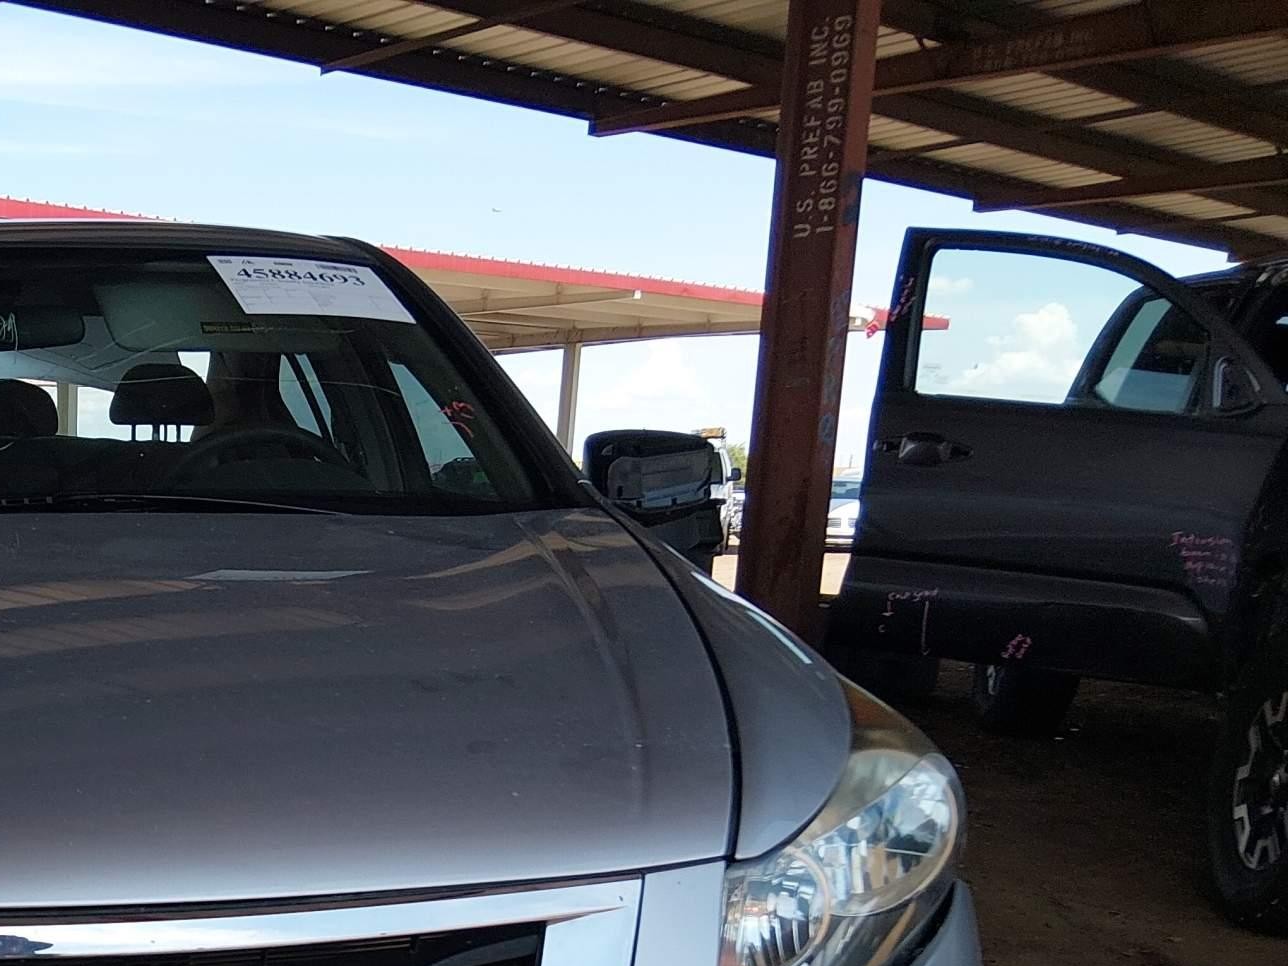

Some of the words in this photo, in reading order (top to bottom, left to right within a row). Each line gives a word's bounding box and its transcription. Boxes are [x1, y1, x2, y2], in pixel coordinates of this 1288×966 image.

[808, 15, 832, 65] INC.
[798, 78, 826, 176] PREFAB
[815, 13, 854, 233] 1-866-799-0969
[793, 190, 817, 239] U.S.
[236, 266, 367, 288] 45884693
